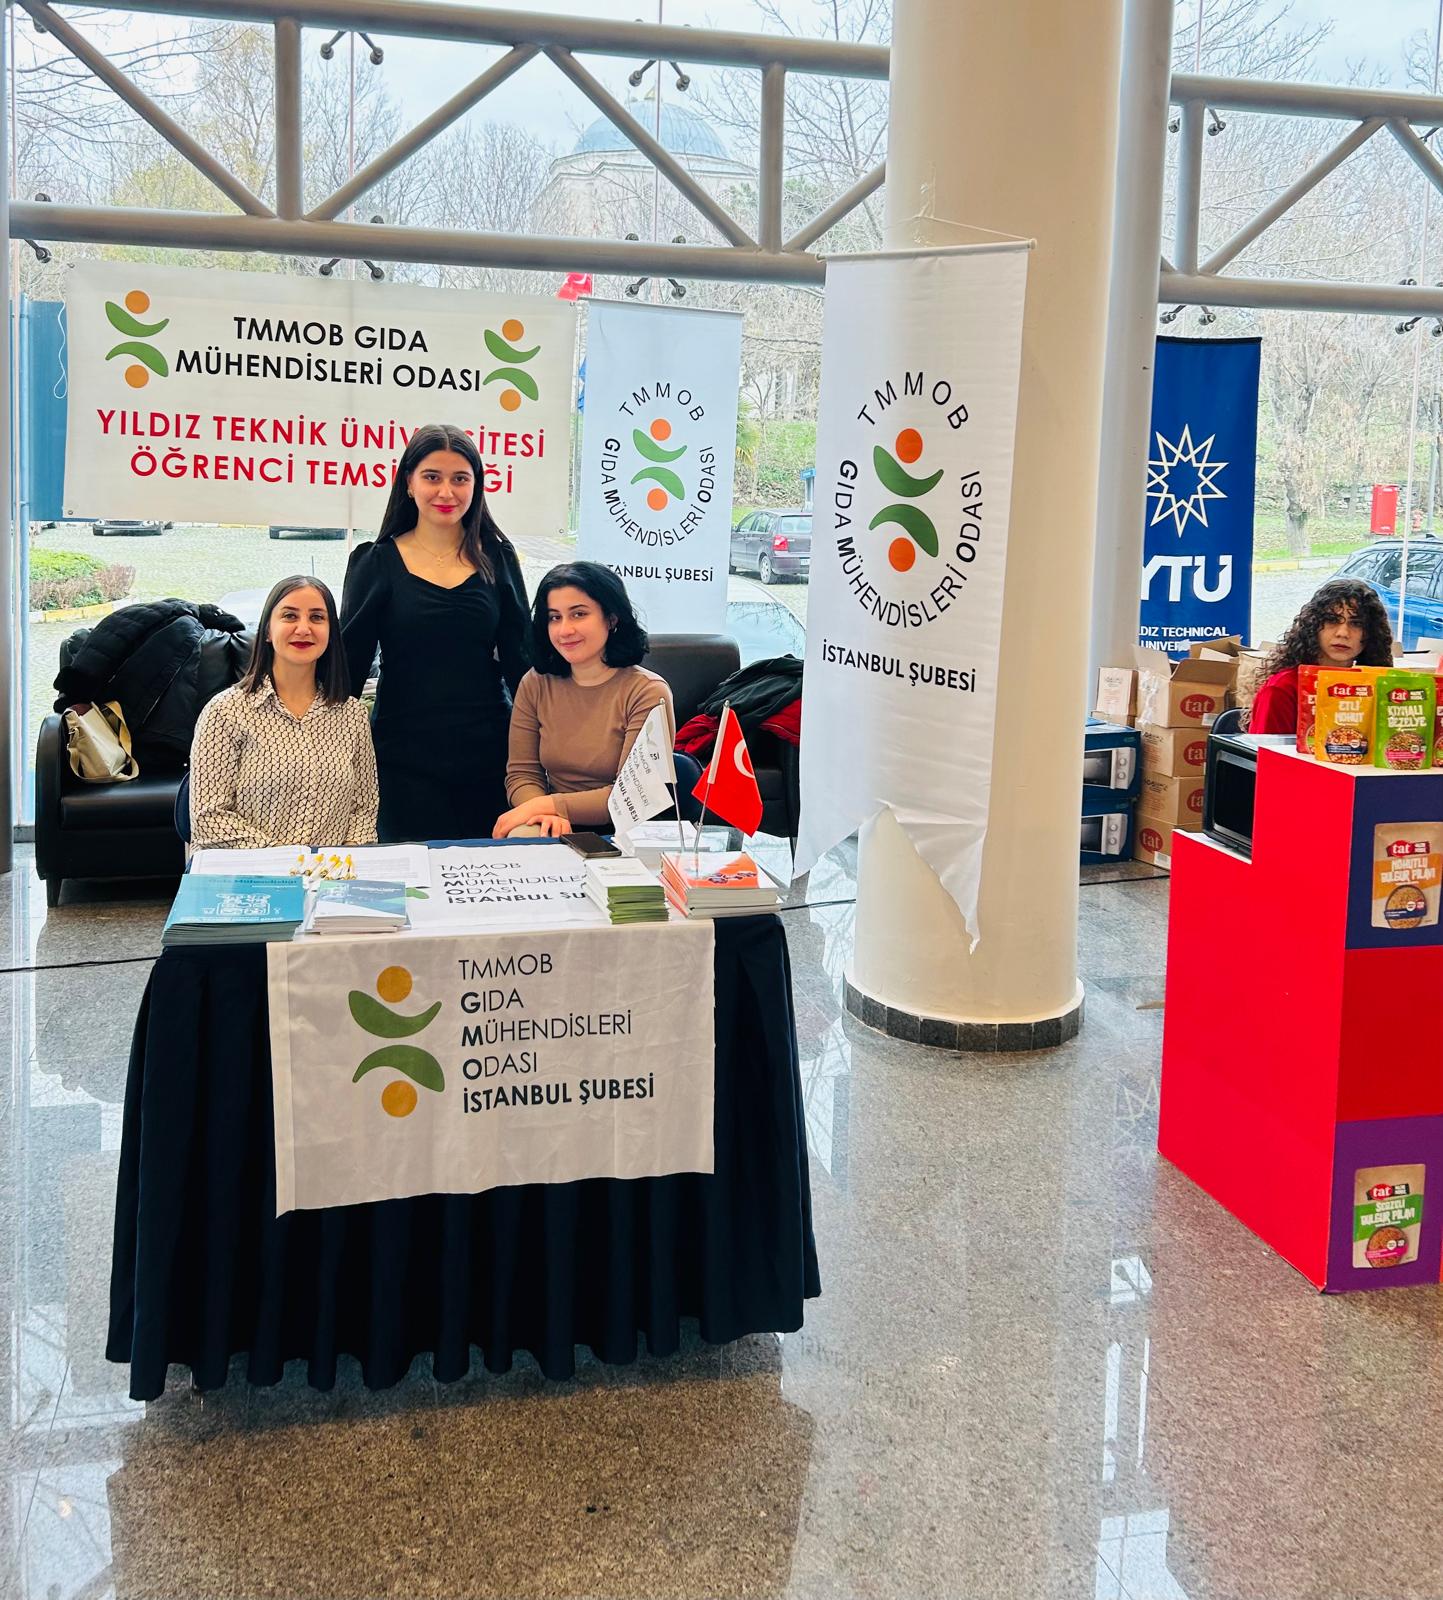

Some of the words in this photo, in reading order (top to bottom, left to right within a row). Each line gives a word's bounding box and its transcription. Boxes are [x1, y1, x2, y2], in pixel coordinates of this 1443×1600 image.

[233, 316, 344, 347] TMMOB
[354, 325, 429, 353] GIDA
[175, 346, 383, 386] MÜHENDİSLERİ
[392, 364, 481, 392] ODASI
[619, 382, 705, 421] TMMOB
[857, 371, 969, 430] TMMOB
[97, 408, 201, 440] YILDIZ
[213, 413, 328, 448] TEKNİK
[341, 417, 545, 458] ÜNİVİTESİ
[130, 445, 294, 484] ÖĞRENCİ
[306, 459, 513, 494] TEMSİĞİ
[601, 438, 621, 485] GIDA
[697, 446, 716, 503] ODASI
[835, 459, 858, 529] GIDA
[603, 489, 706, 547] MÜHENDİSLERİ
[956, 470, 984, 563] ODASI
[665, 567, 713, 583] ŞUBESİ
[836, 537, 967, 629] MÜHENDİSLERİ
[1161, 627, 1230, 637] TECHNICAL
[822, 638, 904, 679] İSTANBUL
[909, 662, 976, 693] ŞUBESİ
[1333, 686, 1351, 696] tat
[1391, 690, 1407, 701] tat
[1185, 697, 1210, 714] tat
[1188, 747, 1205, 761] ta
[1191, 794, 1204, 807] ta
[1142, 834, 1161, 850] tat
[1392, 843, 1410, 854] tat
[440, 863, 521, 871] TMMOB
[446, 886, 517, 895] ODASI
[448, 893, 553, 904] İSTANBUL
[458, 953, 553, 981] TMMOB
[460, 988, 524, 1014] GIDA
[461, 1009, 632, 1047] MÜHENDİSLERİ
[462, 1052, 537, 1080] ODASI
[463, 1079, 573, 1114] İSTANBUL
[578, 1072, 655, 1105] ŞUBESİ
[1372, 1186, 1392, 1197] tat
